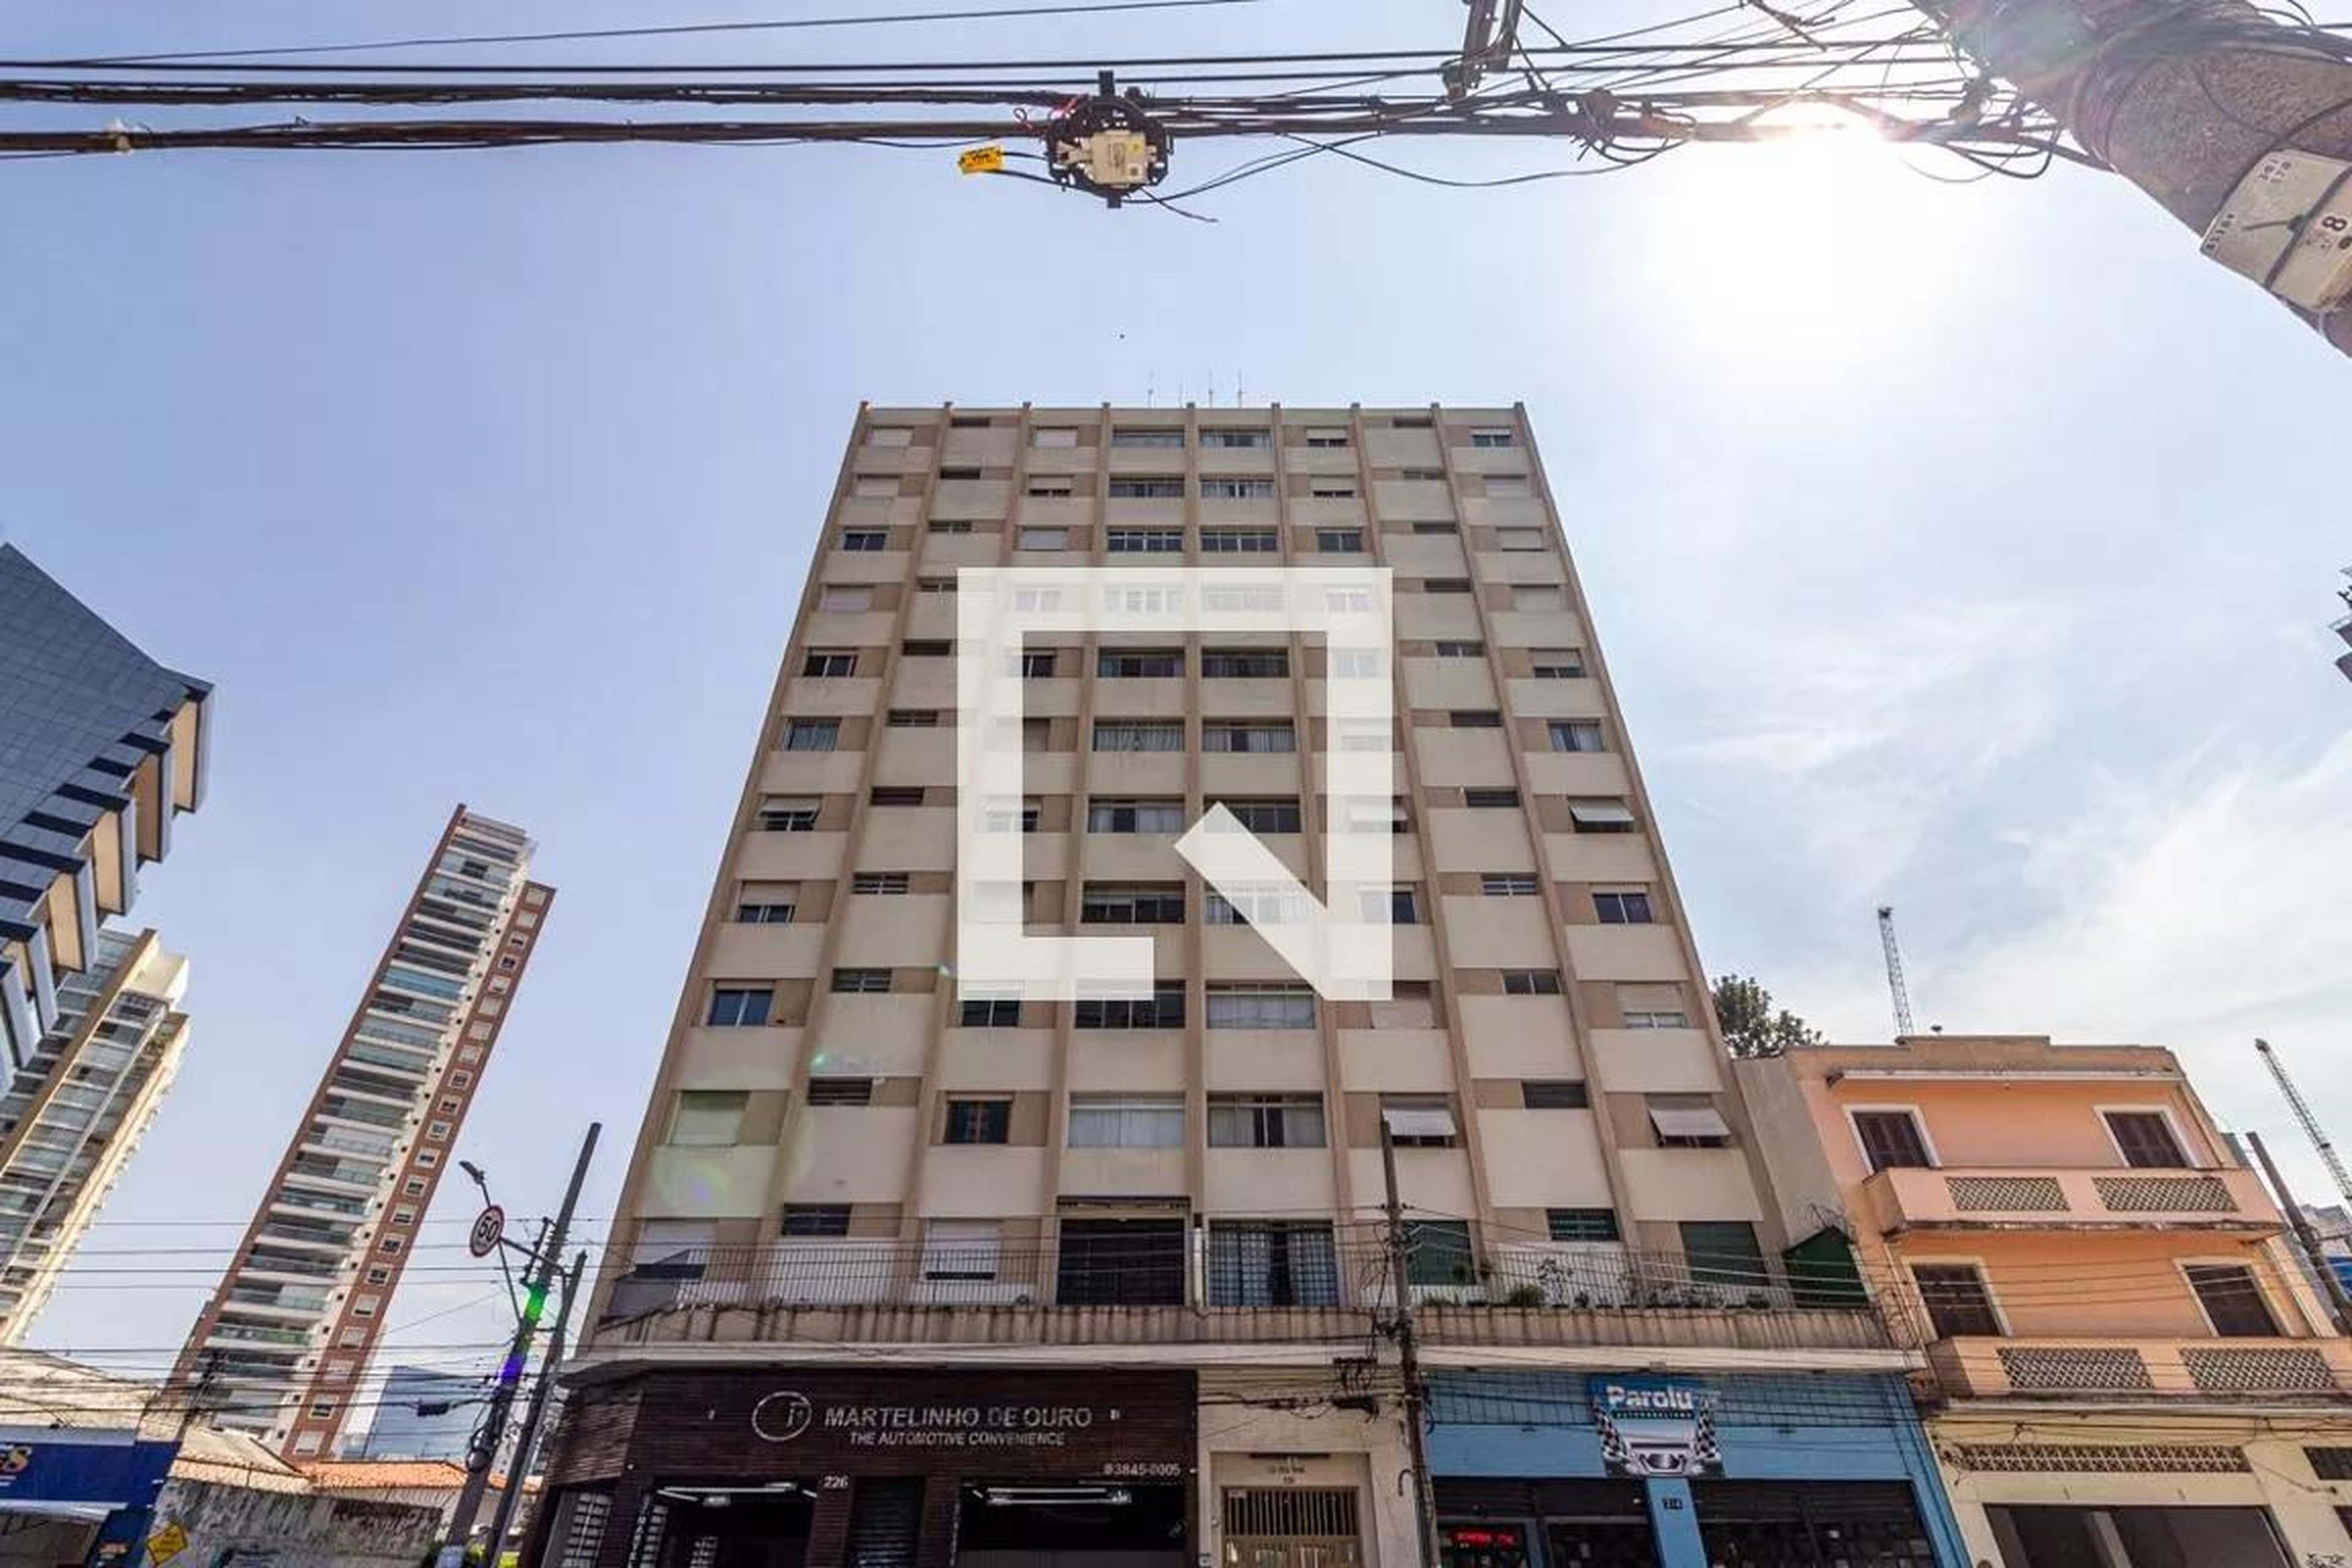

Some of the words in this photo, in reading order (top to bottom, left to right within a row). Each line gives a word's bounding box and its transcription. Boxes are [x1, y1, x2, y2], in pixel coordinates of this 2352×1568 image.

[478, 1216, 499, 1242] 50
[824, 1407, 980, 1427] MARTELINHO
[987, 1407, 1018, 1427] DE
[1023, 1407, 1093, 1427] OURO
[850, 1431, 875, 1445] THE
[877, 1431, 966, 1446] AUTOMOTIVE
[968, 1431, 1066, 1446] CONVENIENCE
[823, 1475, 849, 1489] 226
